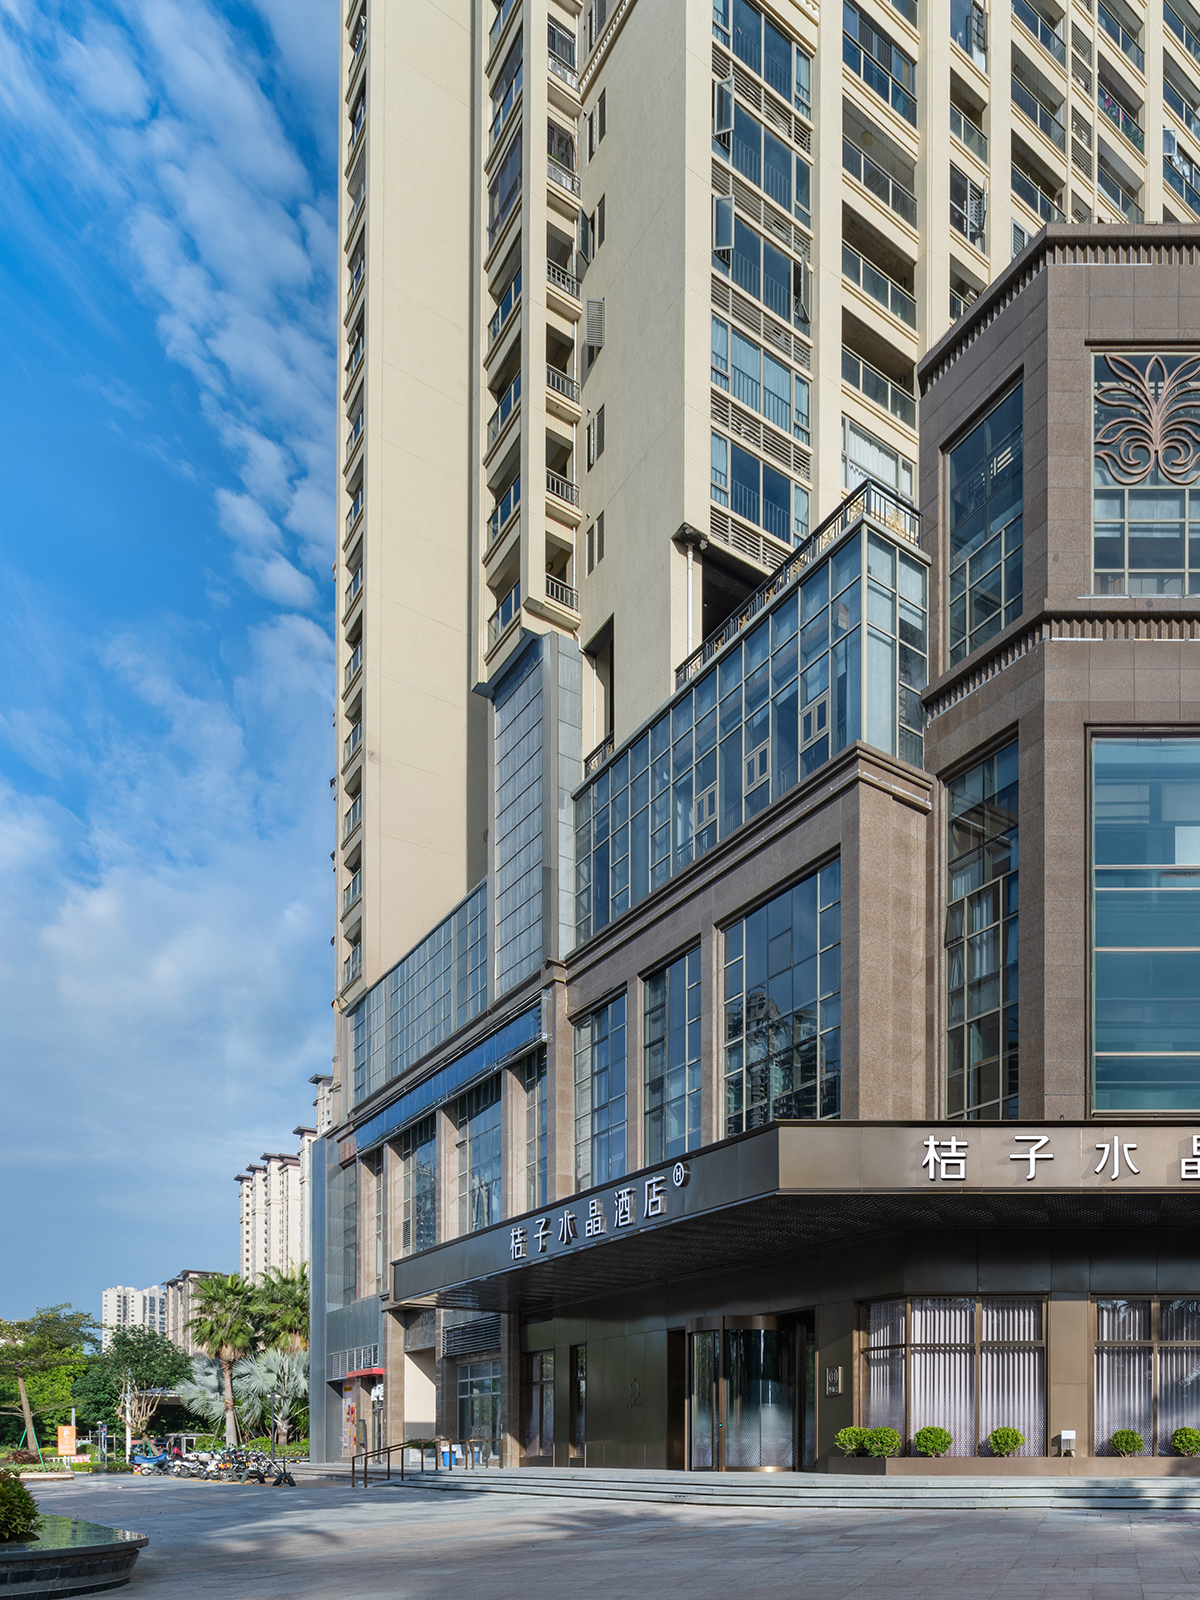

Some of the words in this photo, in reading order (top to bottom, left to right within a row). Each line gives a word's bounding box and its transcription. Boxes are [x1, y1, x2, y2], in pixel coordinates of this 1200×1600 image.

[509, 1175, 668, 1260] 桔子水晶酒店
